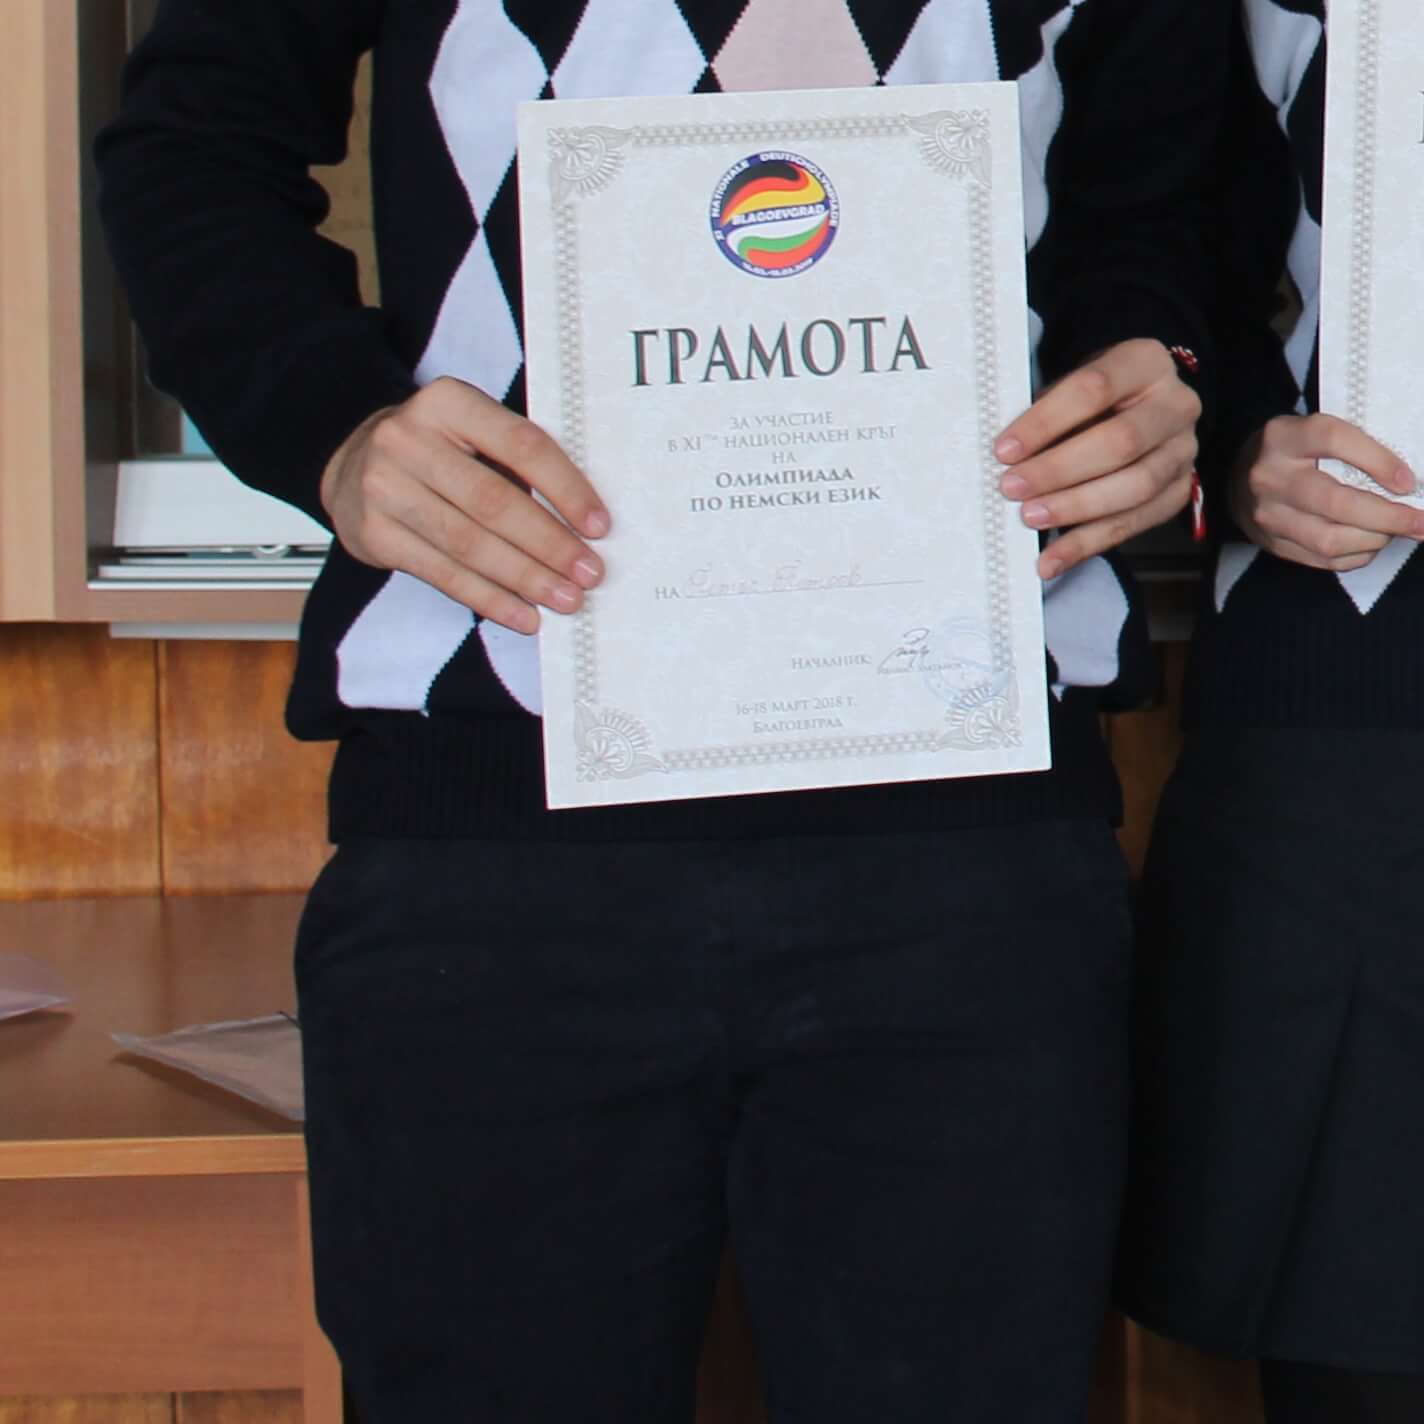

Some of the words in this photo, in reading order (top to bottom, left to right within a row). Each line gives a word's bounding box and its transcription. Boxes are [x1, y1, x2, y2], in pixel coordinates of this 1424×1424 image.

[711, 160, 750, 217] NATIONALE
[732, 204, 825, 225] BLAGOEVGRAD
[630, 314, 932, 388] ГРАМОТА
[731, 416, 750, 430] ЗА
[755, 411, 833, 428] УЧАСТИЕ
[667, 439, 678, 452] В
[724, 428, 849, 449] НАЦИОНАЛЕН
[857, 425, 897, 441] КРЪГ
[771, 452, 798, 464] НА
[689, 496, 723, 513] ПО
[729, 490, 820, 510] НЕМСКИ
[828, 486, 882, 504] ЕЗИК
[655, 585, 681, 600] НА
